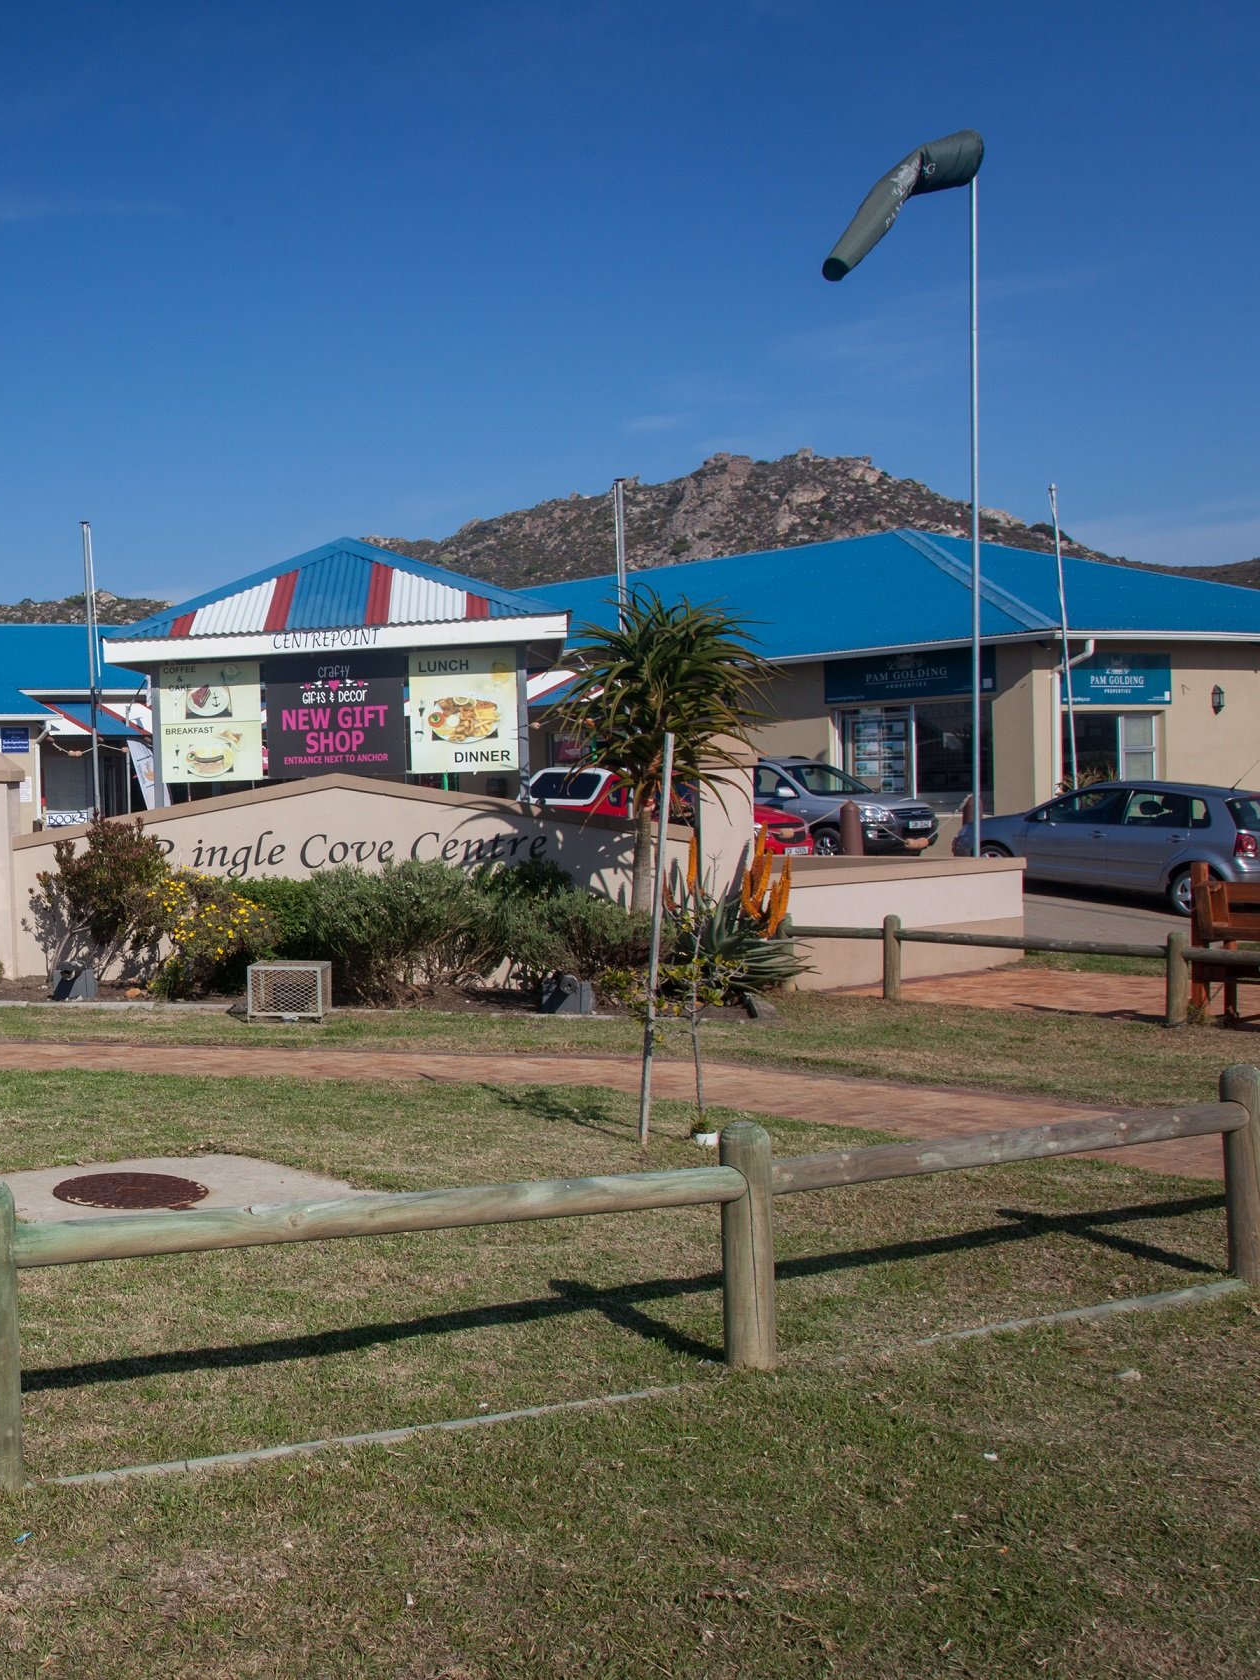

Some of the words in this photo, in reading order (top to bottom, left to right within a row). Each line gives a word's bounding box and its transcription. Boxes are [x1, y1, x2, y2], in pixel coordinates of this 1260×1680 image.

[273, 628, 381, 649] CENTREPOINT
[163, 666, 196, 674] COFFEE
[317, 665, 350, 678] crafty
[418, 659, 469, 673] LUNCH
[866, 672, 889, 682] PAM
[893, 667, 948, 680] GOLDING
[1090, 675, 1107, 685] PAM
[1108, 675, 1144, 685] GOLDING
[168, 684, 193, 692] CAKE
[281, 708, 331, 731] NEW
[337, 705, 388, 729] GIFT
[165, 726, 214, 735] BREAKFAST
[305, 731, 365, 754] SHOP
[284, 756, 323, 765] ENTRANCE
[324, 755, 343, 764] NEXT
[345, 754, 355, 763] TO
[357, 753, 388, 762] ANCHOR
[454, 750, 511, 763] DINNER
[48, 813, 87, 825] BOOKS
[300, 834, 393, 869] Cove
[411, 831, 548, 867] Centre
